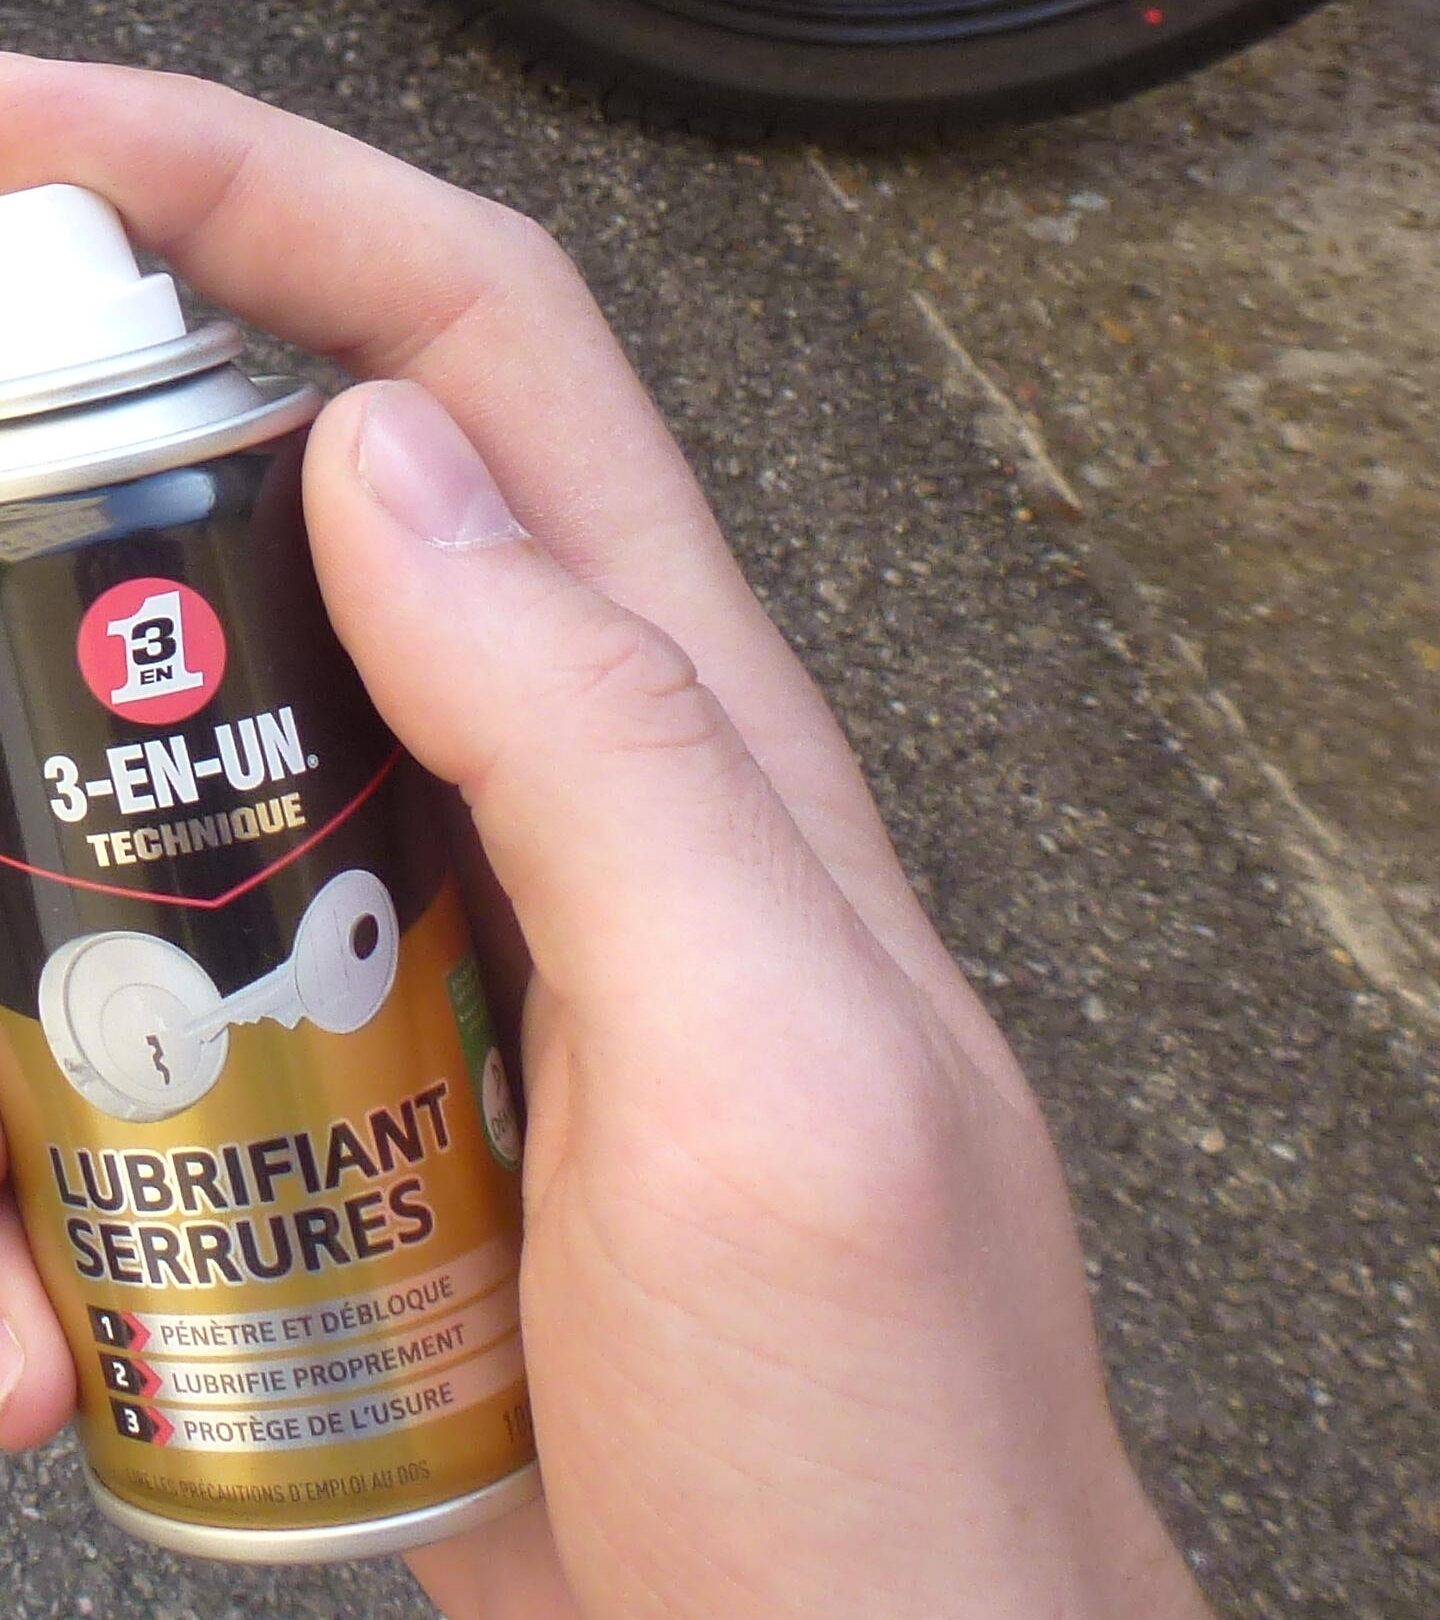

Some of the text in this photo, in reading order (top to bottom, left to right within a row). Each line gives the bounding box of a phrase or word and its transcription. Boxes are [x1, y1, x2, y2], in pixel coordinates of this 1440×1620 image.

[131, 617, 177, 666] 3
[139, 664, 174, 686] EN
[86, 791, 307, 868] TECHNIQUE
[50, 1082, 449, 1212] LUBRIFIANT
[66, 1180, 435, 1285] SERRURES
[160, 1319, 277, 1347] PÉNÈTRE
[283, 1315, 314, 1341] ET
[321, 1275, 455, 1334] DÉBLOQUE
[171, 1369, 288, 1395] LUBRIFIE
[291, 1322, 466, 1389] PROPREMENT
[184, 1415, 302, 1444] PROTÈGE
[308, 1412, 345, 1437] DE
[350, 1381, 455, 1430] L'USURE
[179, 1477, 286, 1504] PRÉCAUTIONS
[289, 1473, 370, 1503] D'EMPLOI
[370, 1468, 394, 1489] AU
[397, 1459, 432, 1486] DOS
